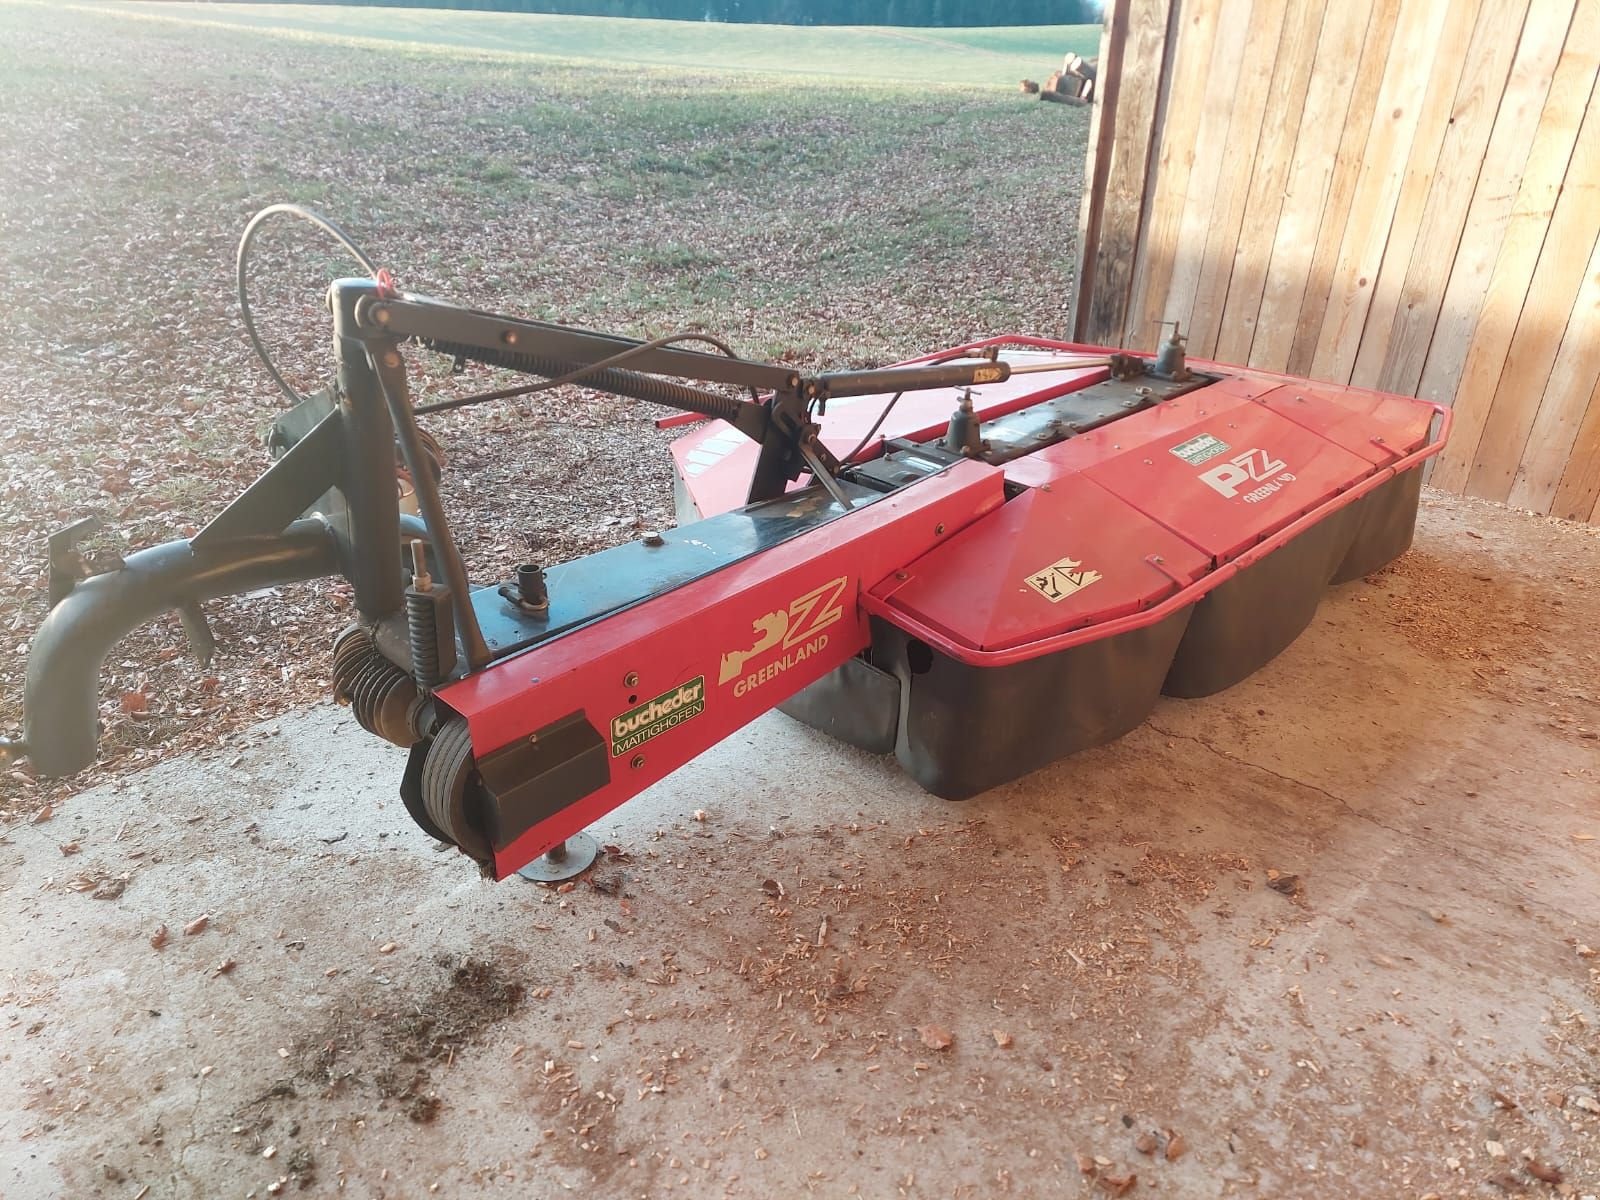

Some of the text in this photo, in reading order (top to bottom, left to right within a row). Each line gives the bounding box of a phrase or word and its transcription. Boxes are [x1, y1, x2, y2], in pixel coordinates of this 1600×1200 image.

[1198, 448, 1287, 498] PZ
[733, 634, 829, 698] GREENLAND
[614, 682, 702, 738] bucheder
[616, 703, 702, 754] MATTIGHOFEN
